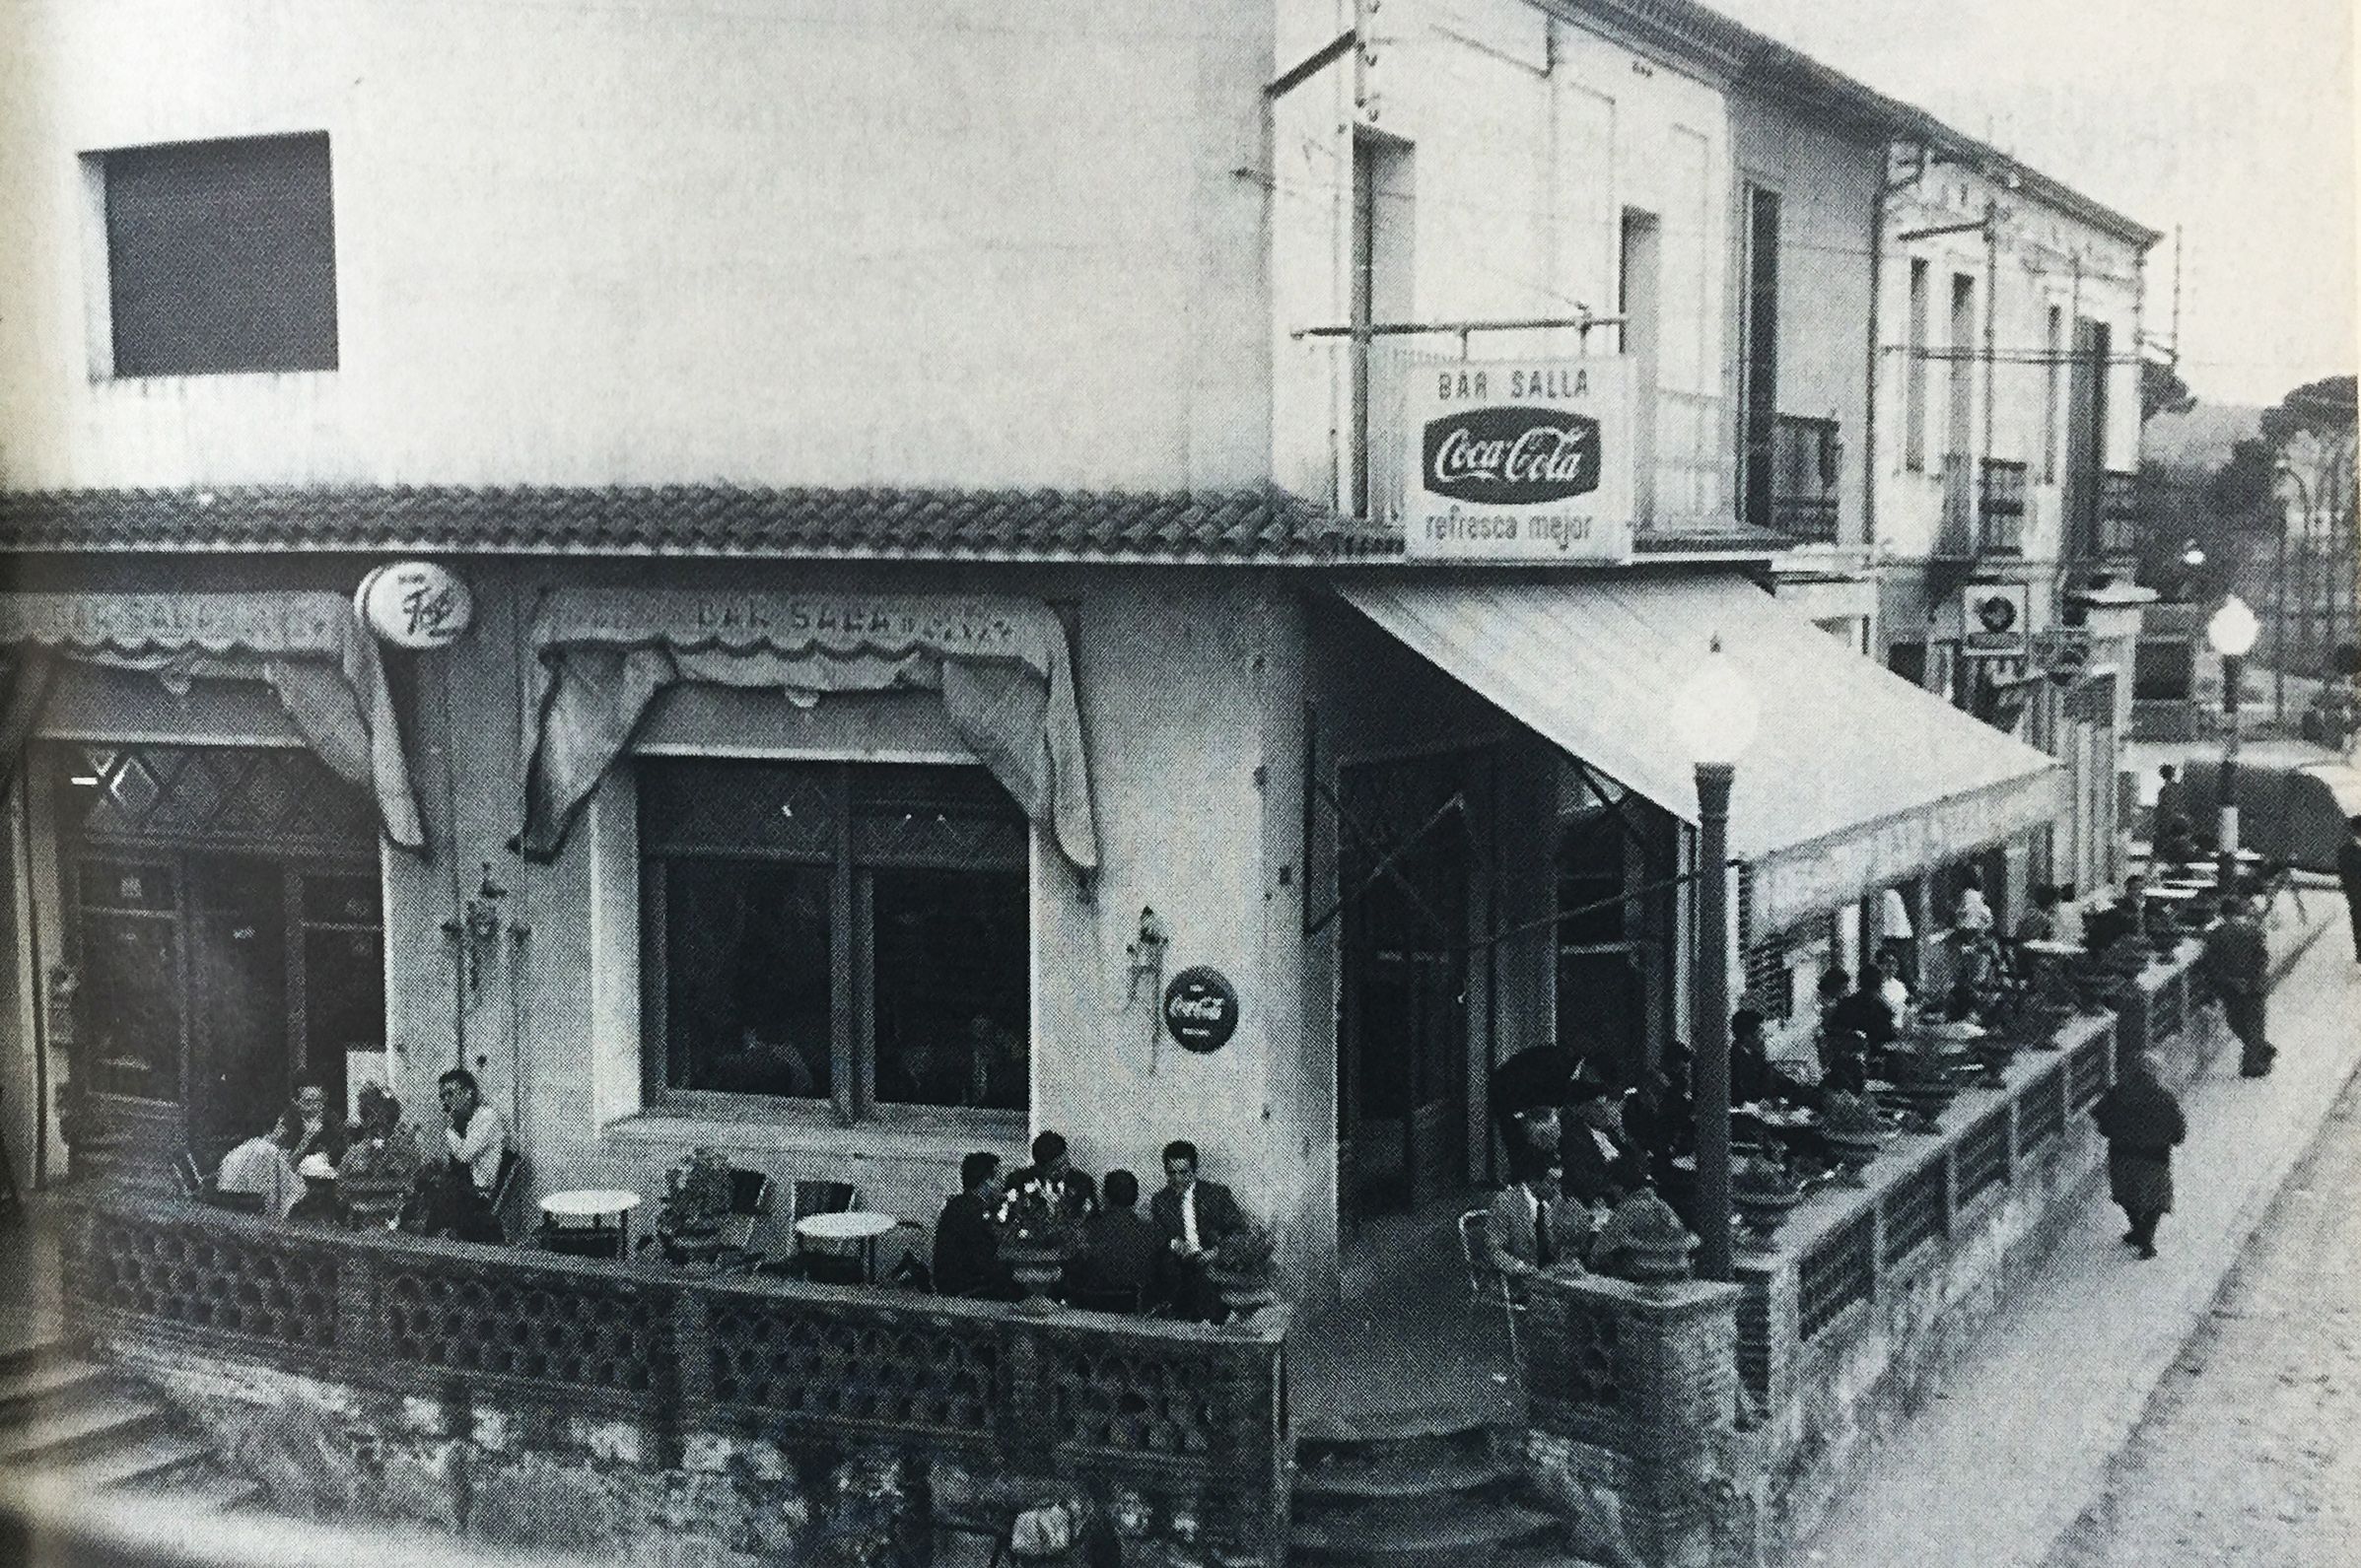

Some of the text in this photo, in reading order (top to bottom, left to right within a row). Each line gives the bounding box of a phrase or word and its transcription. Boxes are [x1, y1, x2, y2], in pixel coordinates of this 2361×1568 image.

[1438, 368, 1590, 400] BAR SALLA
[1425, 504, 1593, 551] refresca mejor
